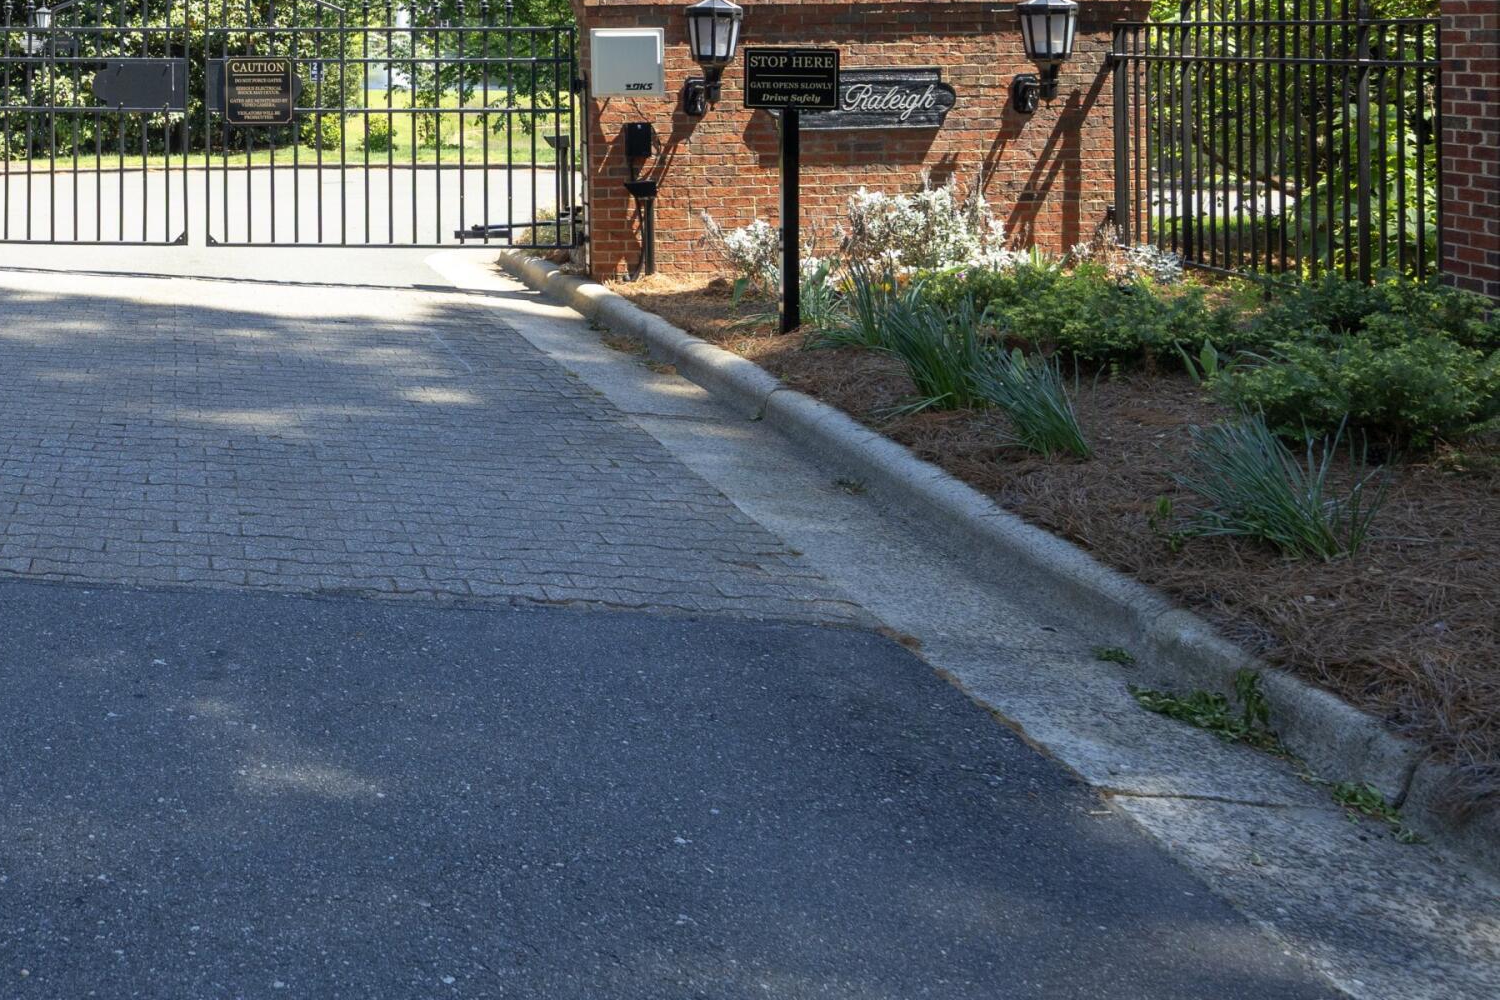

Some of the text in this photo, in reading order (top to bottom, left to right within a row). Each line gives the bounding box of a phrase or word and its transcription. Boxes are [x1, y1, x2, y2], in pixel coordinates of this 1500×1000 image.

[231, 62, 285, 73] CAUTION
[749, 55, 834, 69] STOP HERE
[749, 81, 833, 90] GATE OPENS SLOWLY
[761, 93, 821, 103] Drive Safely
[842, 83, 936, 121] Raleigh
